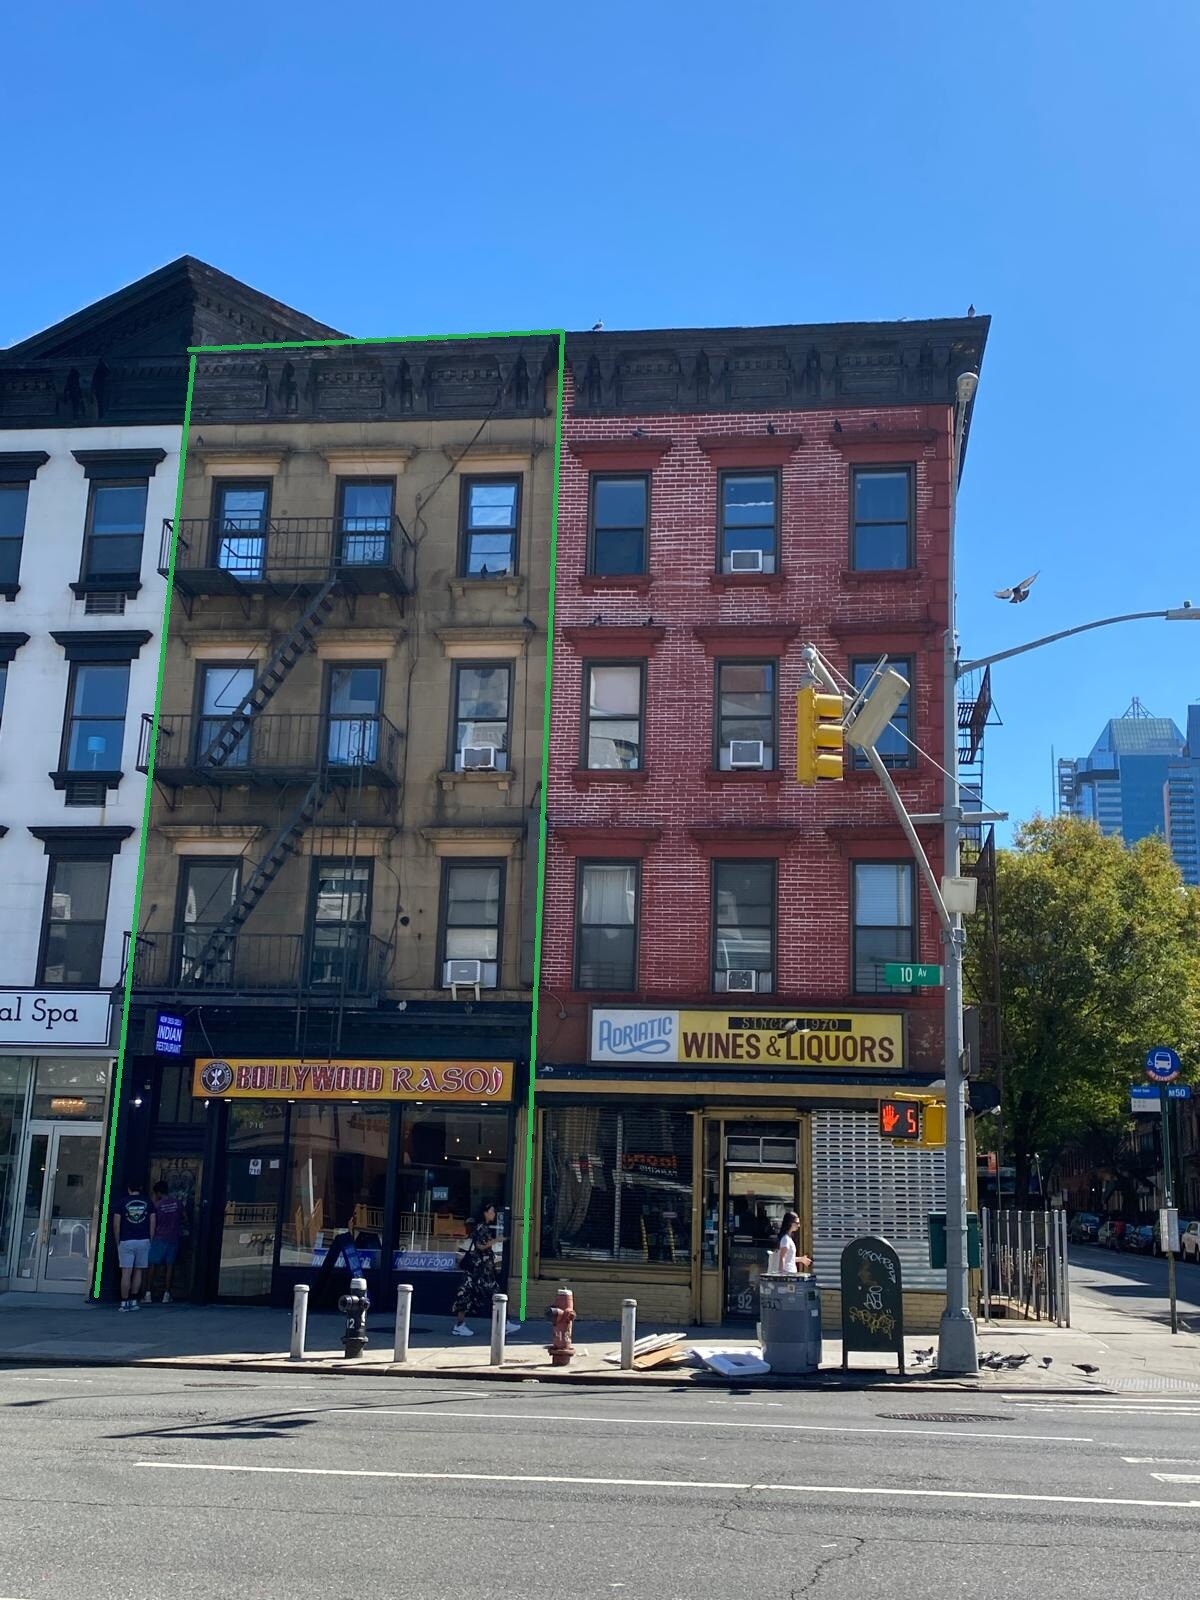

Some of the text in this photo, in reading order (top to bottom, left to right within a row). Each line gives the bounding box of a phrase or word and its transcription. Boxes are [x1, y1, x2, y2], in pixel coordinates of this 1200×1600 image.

[901, 967, 927, 982] 10 Av
[32, 998, 79, 1030] Spa
[742, 1017, 839, 1031] SINCE 1970
[157, 1024, 183, 1042] INDIAN
[682, 1031, 895, 1063] WINES & LIQUORS
[235, 1065, 384, 1092] BOLLYWOOD
[1168, 1088, 1186, 1097] M50
[907, 1109, 916, 1133] 5
[433, 1191, 447, 1199] OPEN
[394, 1257, 455, 1267] INDIAN FOOD
[737, 1294, 753, 1310] 92
